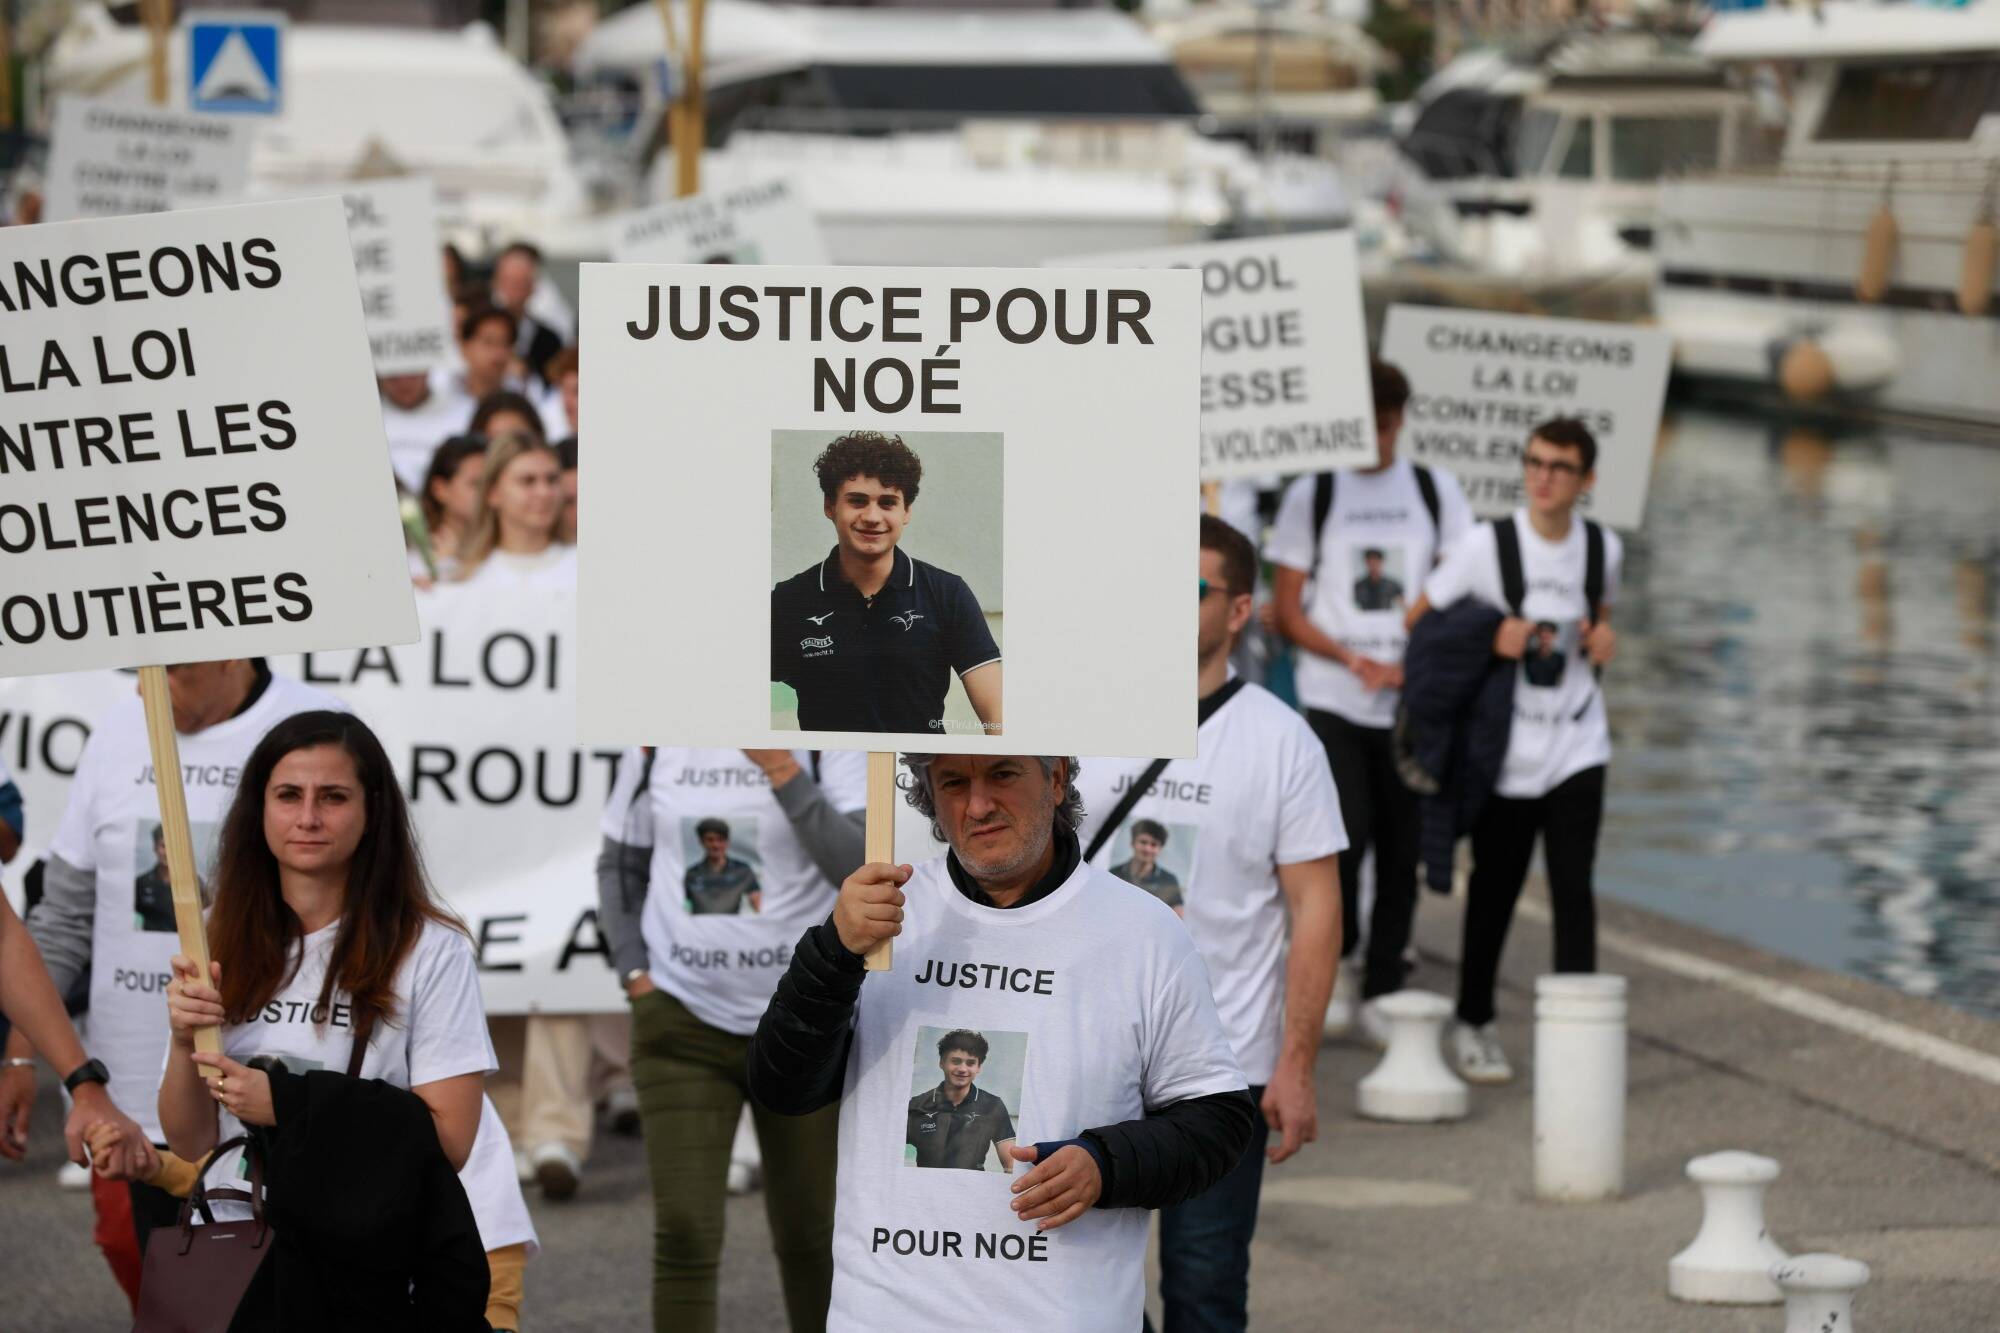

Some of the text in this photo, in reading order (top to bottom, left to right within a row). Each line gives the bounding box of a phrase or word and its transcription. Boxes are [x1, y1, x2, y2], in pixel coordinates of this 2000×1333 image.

[626, 285, 1155, 345] JUSTICE POUR
[0, 328, 196, 393] LA LOI
[1427, 325, 1634, 367] CHANGEONS
[813, 344, 962, 413] NOÉ
[1472, 364, 1577, 396] LA LOI
[177, 400, 297, 458] LES
[1211, 416, 1365, 462] VOLONTAIRE
[0, 571, 313, 645] OUTIÈRES
[431, 629, 560, 690] LOI
[135, 764, 237, 787] JUTICE
[670, 944, 730, 970] POUR
[915, 960, 1055, 995] JUSTICE
[872, 1227, 1048, 1262] POUR NOÉ
